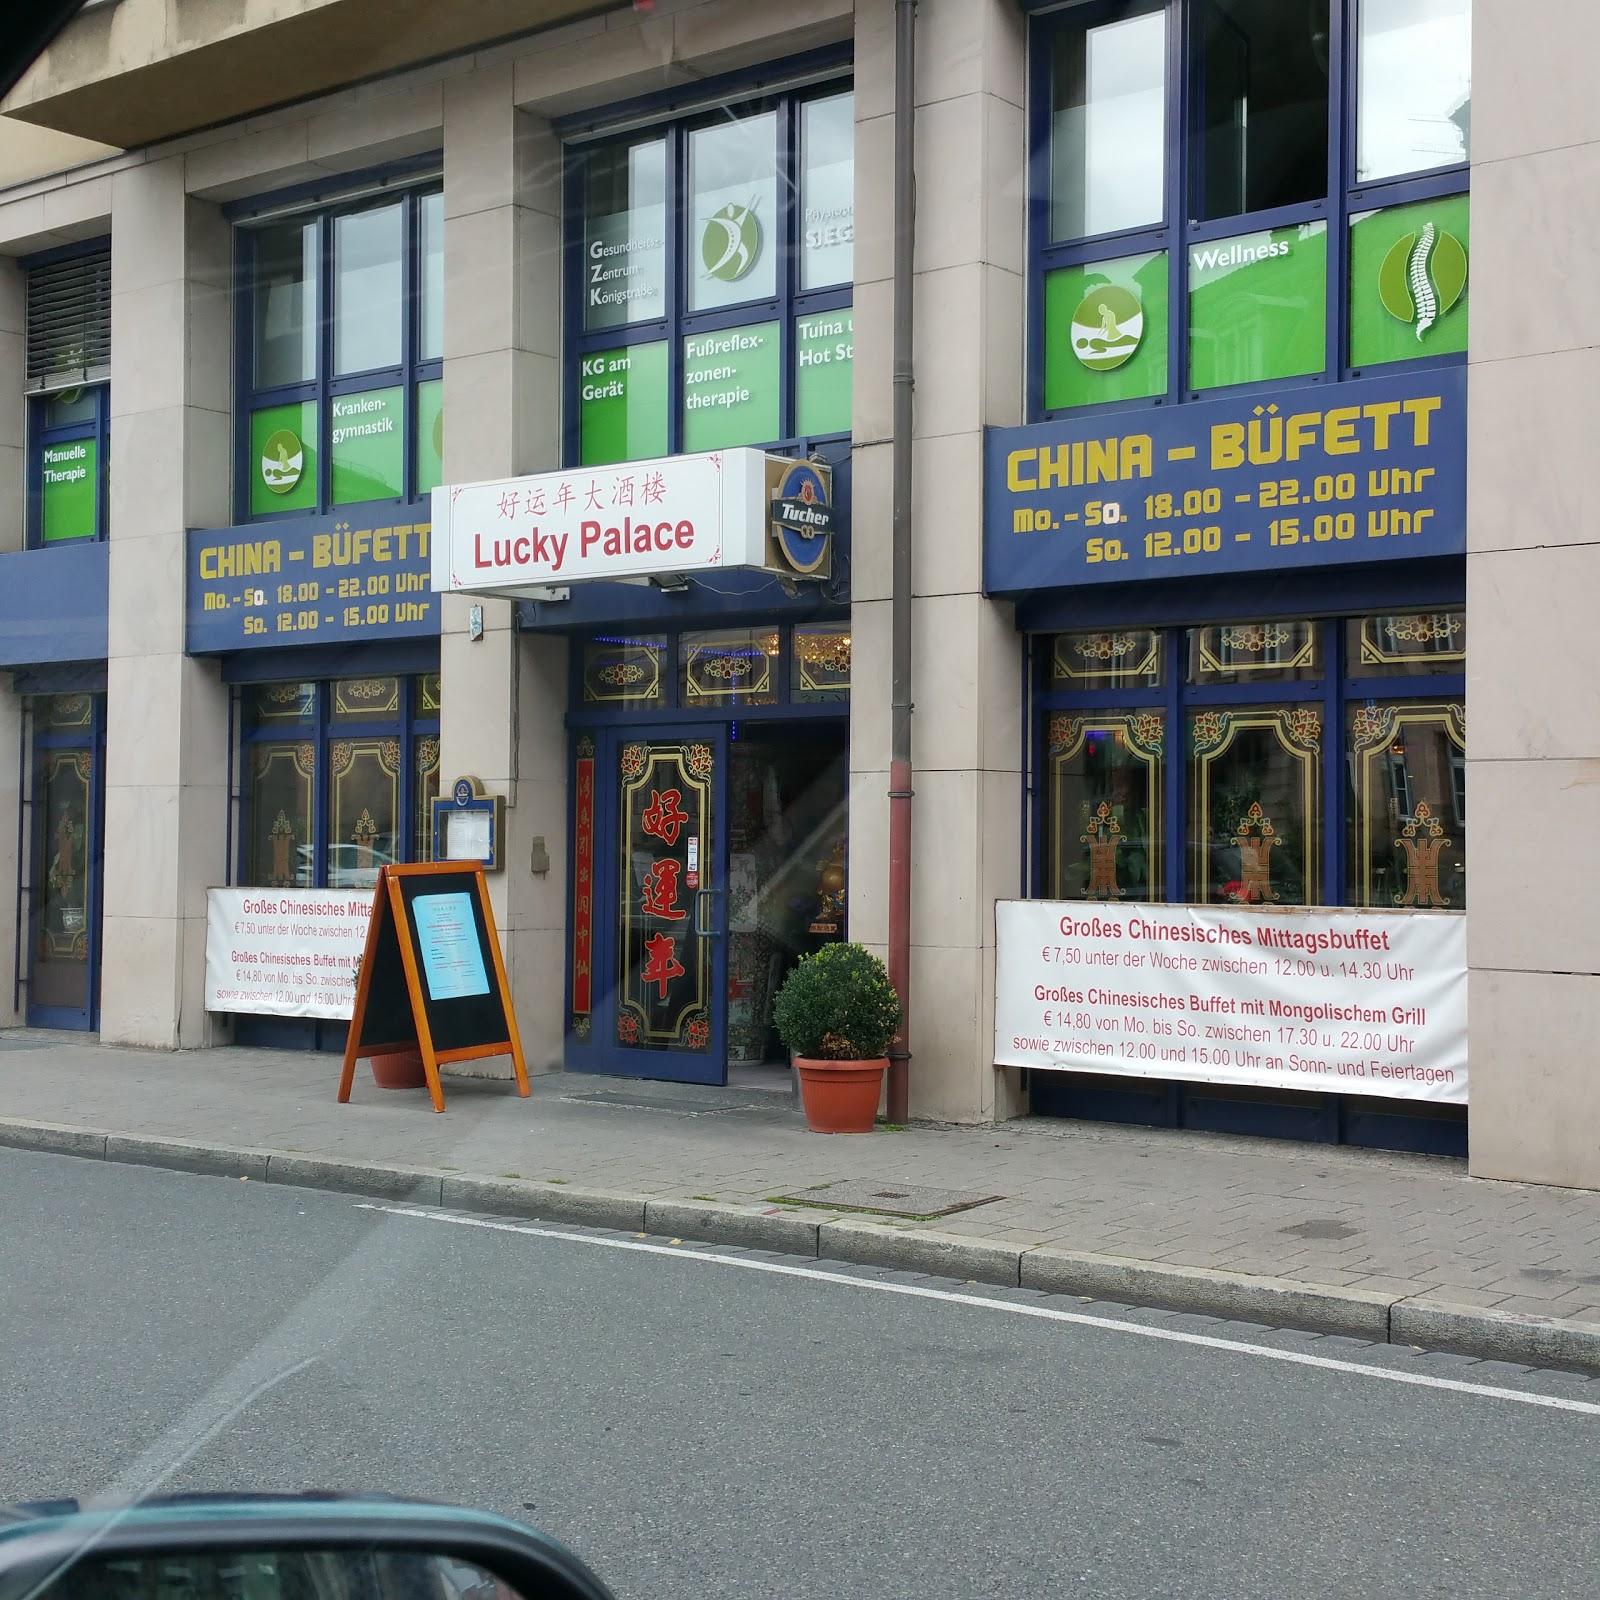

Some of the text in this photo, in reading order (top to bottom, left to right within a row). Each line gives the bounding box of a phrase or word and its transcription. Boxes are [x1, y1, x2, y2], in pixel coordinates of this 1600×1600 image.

[1193, 240, 1289, 271] Wellness
[590, 284, 653, 306] Königstraße
[798, 320, 843, 340] Tuina
[686, 335, 764, 359] Fußreflex-
[799, 349, 831, 367] Hot
[582, 358, 631, 377] KG am
[686, 366, 737, 385] zonen-
[582, 380, 624, 401] Gerät
[686, 386, 750, 410] therapie
[332, 399, 386, 418] Kranken-
[332, 417, 393, 444] gymnastik
[44, 445, 86, 464] Manuelle
[1007, 433, 1153, 493] CHINA
[1210, 395, 1442, 471] BÜFETT
[43, 465, 86, 484] Therapie
[496, 470, 668, 521] 好运年大酒楼
[1143, 487, 1222, 521] 18.00
[1258, 472, 1355, 509] 22.00
[1368, 467, 1437, 499] Uhr
[782, 502, 830, 527] Tucher
[474, 516, 696, 572] Lucky Palace
[1086, 537, 1129, 564] So.
[1143, 526, 1222, 559] 12.00
[1268, 511, 1356, 547] 15.00
[1368, 508, 1436, 539] Uhr
[199, 540, 281, 580] CHINA
[312, 520, 432, 569] BÜFETT
[276, 581, 319, 604] 18.00
[338, 575, 390, 599] 22.00
[395, 572, 430, 593] Uhr
[243, 616, 268, 635] So.
[276, 610, 319, 632] 12.00
[343, 605, 389, 627] 15.00
[394, 602, 430, 623] Uhr
[641, 789, 688, 999] 好運年
[243, 899, 278, 915] Großes
[279, 899, 345, 917] Chinesisches
[257, 922, 276, 936] unter
[277, 922, 289, 936] der
[291, 923, 318, 938] Woche
[319, 926, 353, 939] zwischen
[1059, 915, 1390, 954] Großes Chinesisches Mittagsbuffet
[231, 950, 258, 964] Großes
[259, 951, 311, 966] Chinesisches
[313, 953, 336, 968] Buffet
[338, 955, 351, 969] mit
[1085, 949, 1119, 967] unter
[1122, 950, 1146, 968] der
[1149, 951, 1198, 971] Woche
[1202, 955, 1268, 976] zwischen
[1274, 957, 1316, 978] 12.00
[1320, 964, 1334, 979] u.
[1339, 961, 1382, 981] 14.30
[1386, 962, 1414, 982] Uhr
[263, 973, 276, 984] von
[277, 971, 291, 985] Mo.
[292, 971, 303, 985] bis
[216, 989, 239, 1000] sowie
[240, 989, 273, 1001] zwischen
[295, 991, 311, 1004] und
[336, 993, 351, 1006] Uhr
[1034, 984, 1427, 1026] Großes Chinesisches Buffet mit Mongolischem Grill
[1043, 1010, 1416, 1054] € 14,80 von Mo. bis So. zwischen 17.30 u. 22.00 Uhr
[1012, 1034, 1455, 1086] sowie zwischen 12.00 und 15.00 Uhr an Sonn- und Feiertagen
